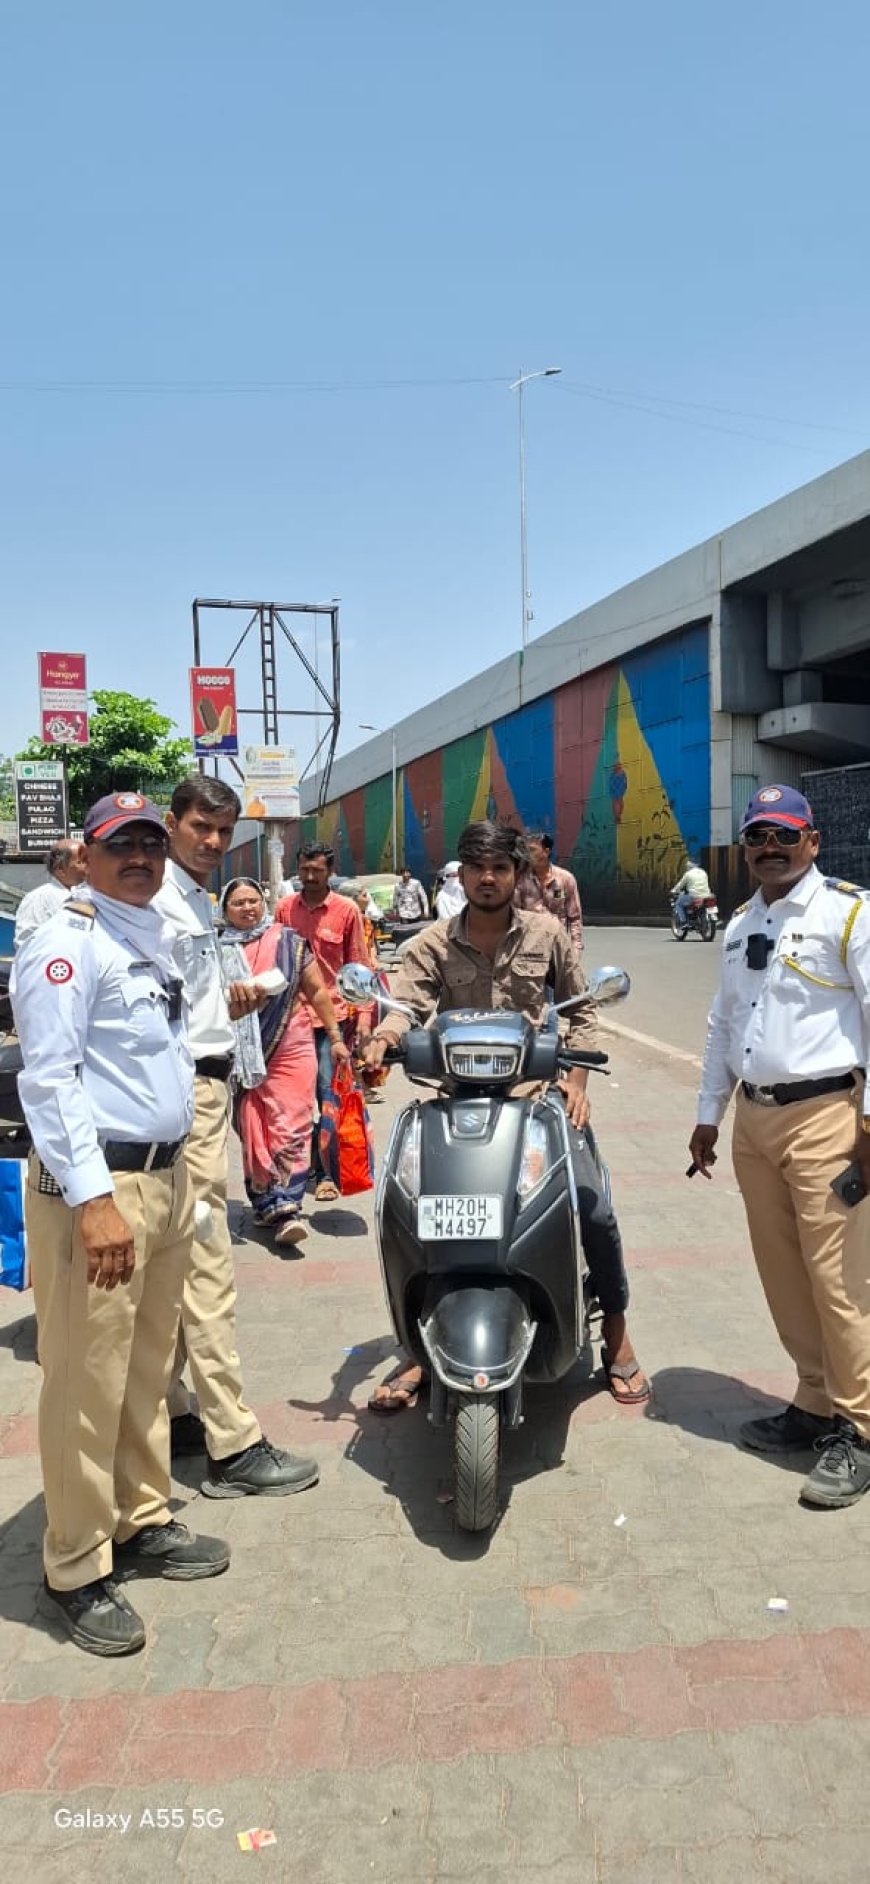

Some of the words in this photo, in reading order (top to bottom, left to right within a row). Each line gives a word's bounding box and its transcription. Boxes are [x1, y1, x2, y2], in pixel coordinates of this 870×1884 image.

[24, 782, 57, 790] CHINESE
[30, 816, 54, 824] PIZZA
[435, 1199, 487, 1217] MH20H
[435, 1218, 487, 1237] M4497
